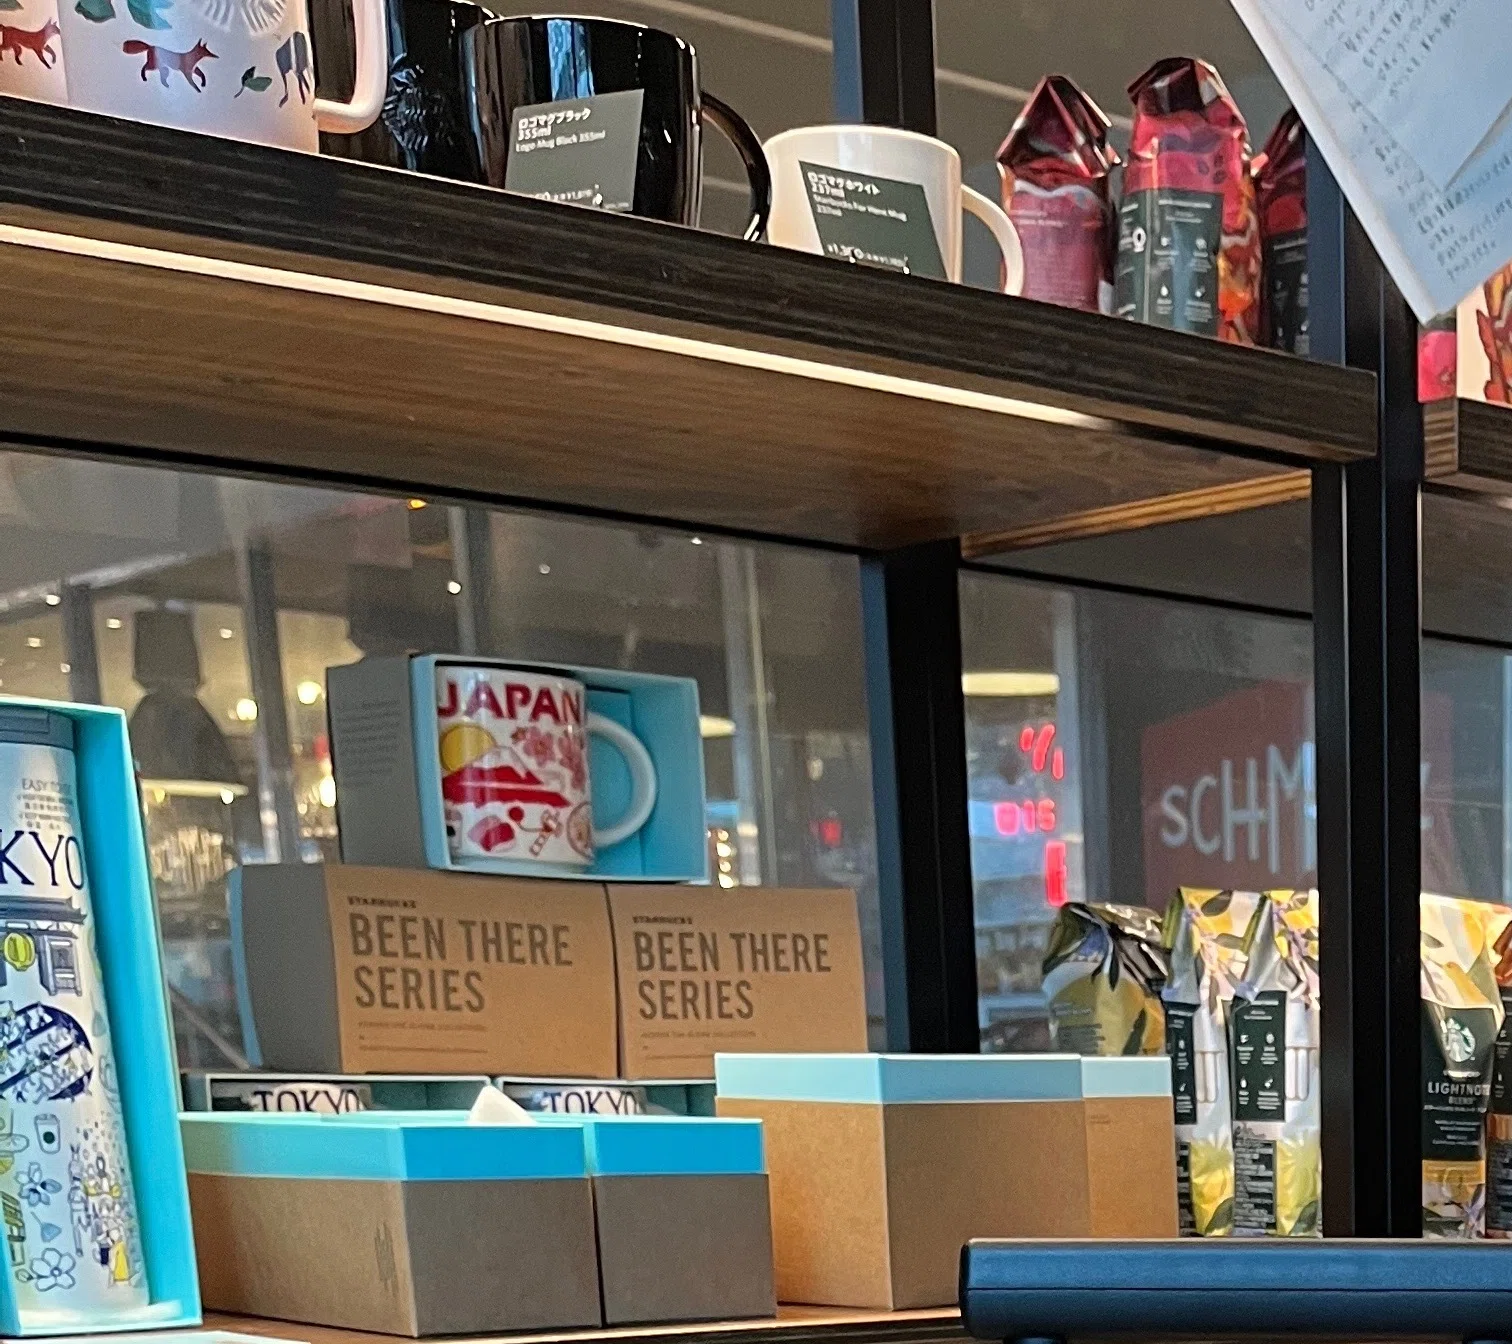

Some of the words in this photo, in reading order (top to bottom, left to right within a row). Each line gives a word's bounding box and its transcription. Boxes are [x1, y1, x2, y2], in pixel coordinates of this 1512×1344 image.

[517, 124, 552, 141] 355ml
[436, 680, 582, 725] JAPAN
[349, 912, 448, 962] BEEN
[457, 918, 574, 968] THERE
[633, 930, 720, 973] BEEN
[728, 932, 832, 973] THERE
[353, 964, 486, 1014] SERIES
[638, 979, 754, 1020] SERIES
[253, 1088, 362, 1115] TOKYO
[544, 1090, 641, 1115] TOKYO
